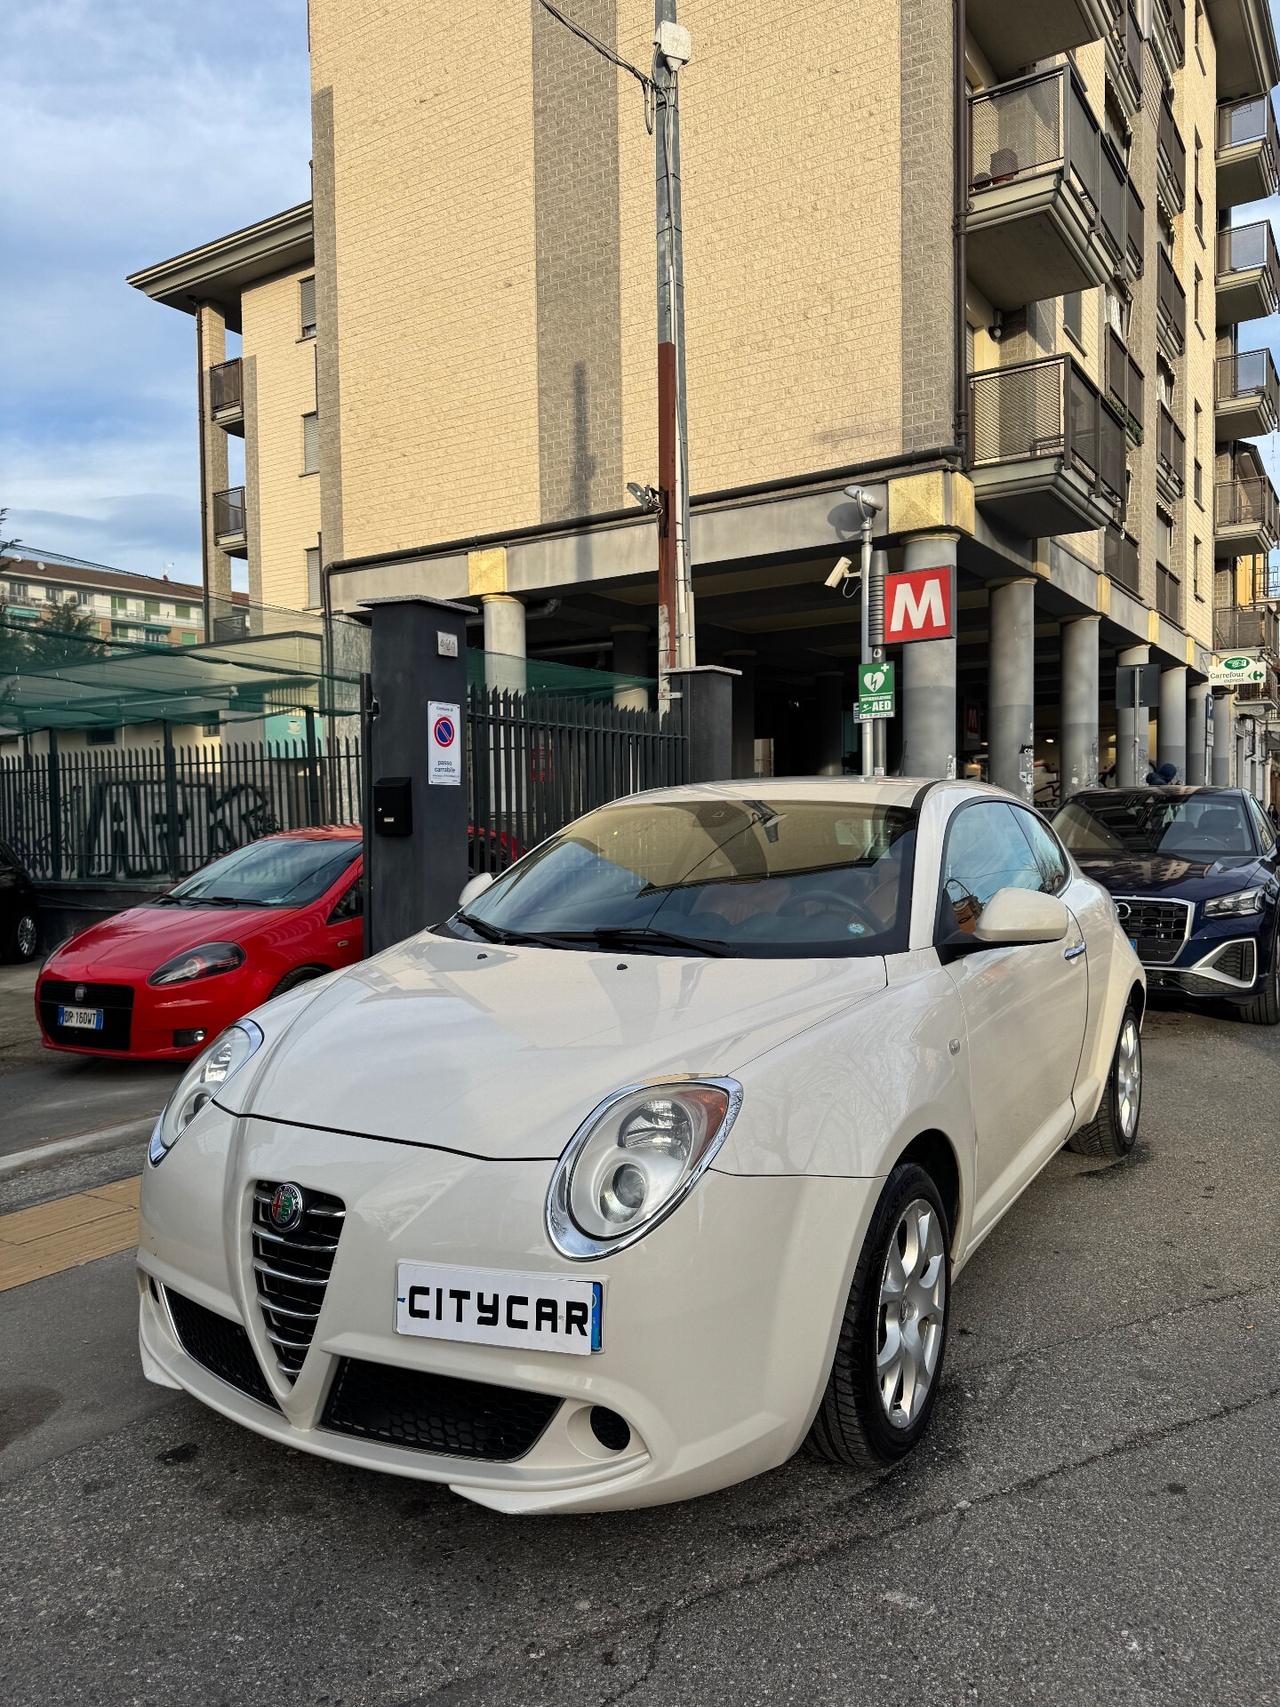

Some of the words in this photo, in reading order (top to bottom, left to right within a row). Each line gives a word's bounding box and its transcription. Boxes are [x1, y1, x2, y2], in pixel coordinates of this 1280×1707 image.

[890, 578, 947, 632] M
[1210, 671, 1245, 679] Carrefour
[872, 700, 892, 712] AED
[408, 1285, 589, 1336] CITYCAR
